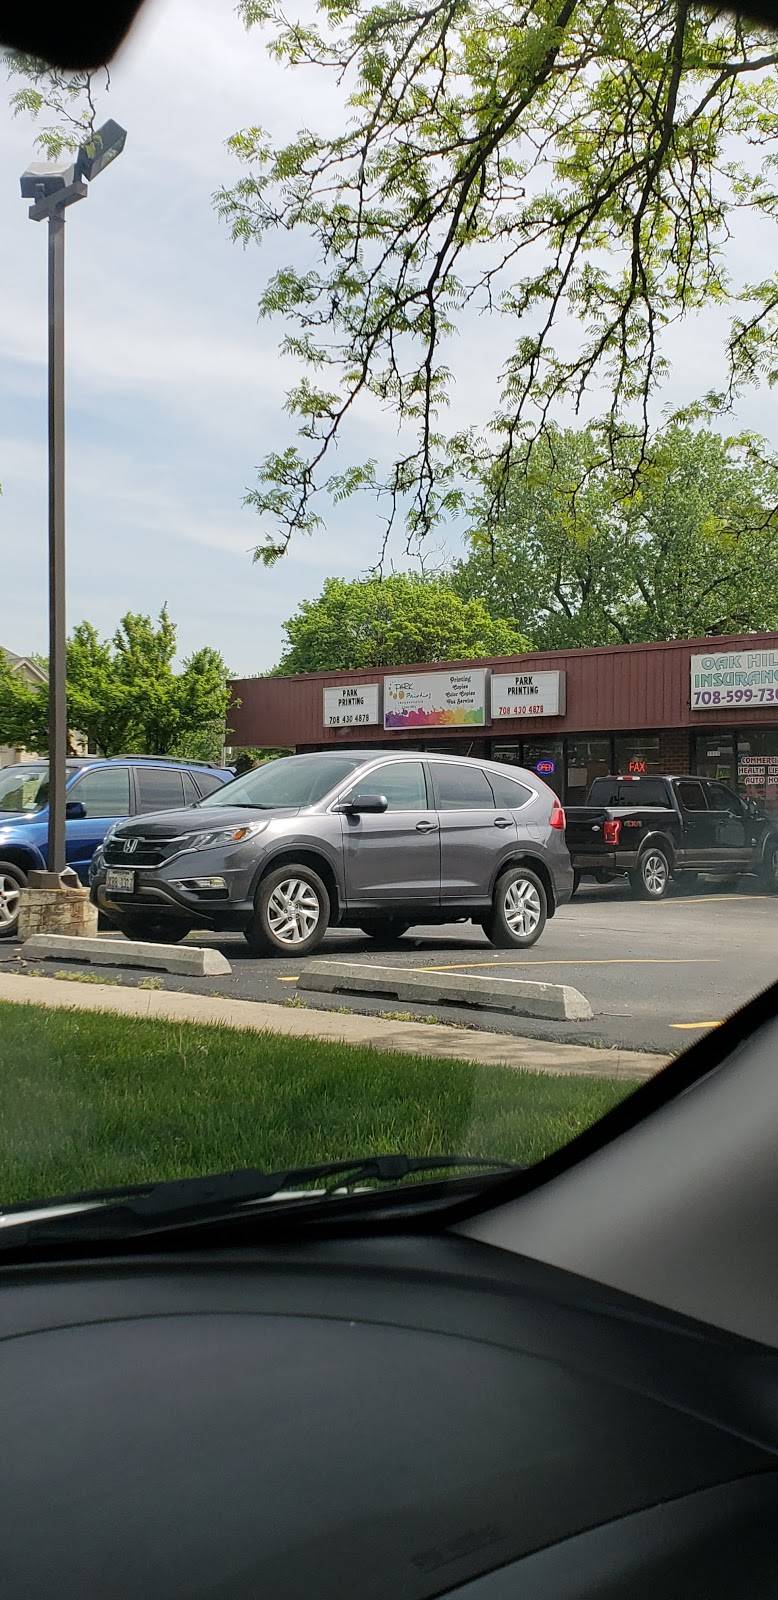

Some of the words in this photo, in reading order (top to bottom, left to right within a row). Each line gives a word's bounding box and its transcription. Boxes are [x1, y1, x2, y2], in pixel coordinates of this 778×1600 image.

[701, 655, 742, 671] OAK
[515, 676, 533, 686] PARK
[342, 689, 358, 697] PARK
[507, 686, 539, 696] PRINTING
[338, 697, 364, 706] PRINTING
[499, 706, 511, 715] 708
[528, 704, 544, 714] 4878
[329, 716, 340, 724] 708
[629, 761, 646, 772] FAX
